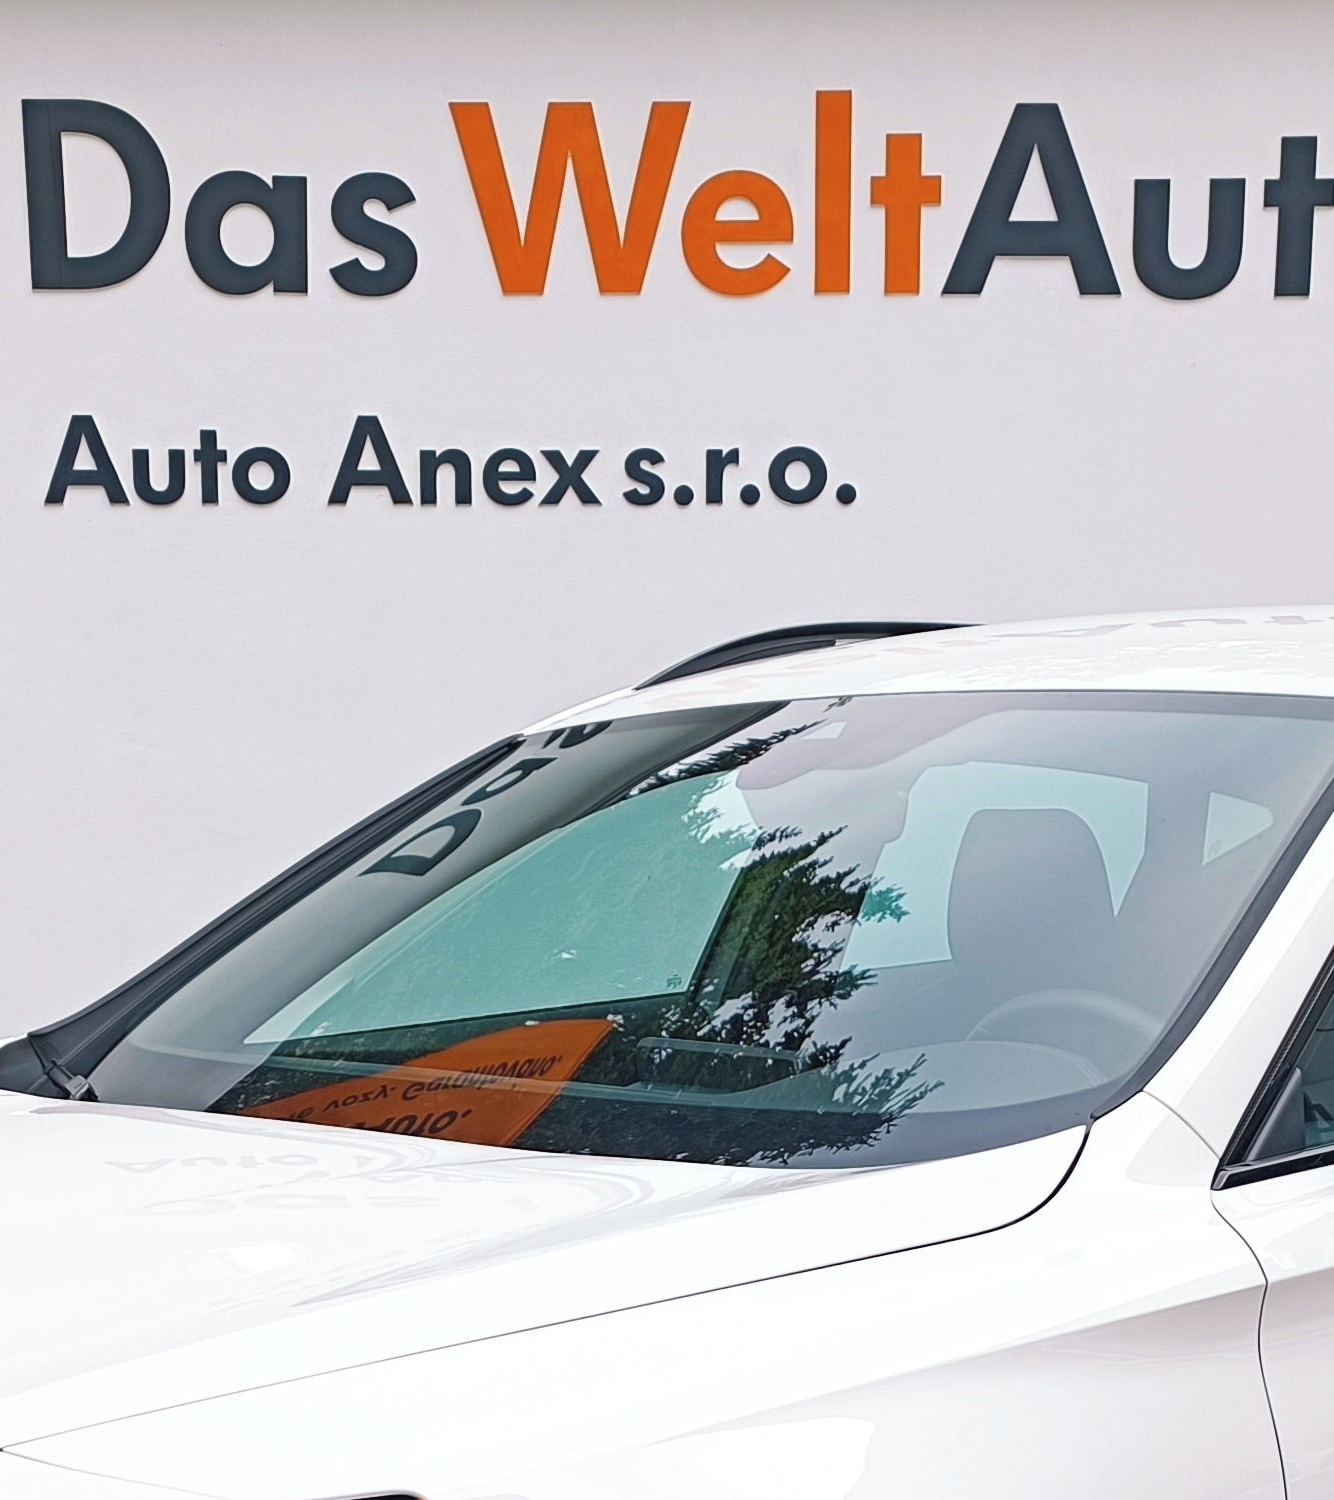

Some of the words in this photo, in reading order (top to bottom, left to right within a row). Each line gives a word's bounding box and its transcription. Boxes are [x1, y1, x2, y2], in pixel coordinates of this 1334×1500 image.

[21, 98, 418, 297] Das
[44, 415, 291, 506] Auto
[327, 415, 603, 506] Anex
[623, 446, 857, 506] s.r.o.
